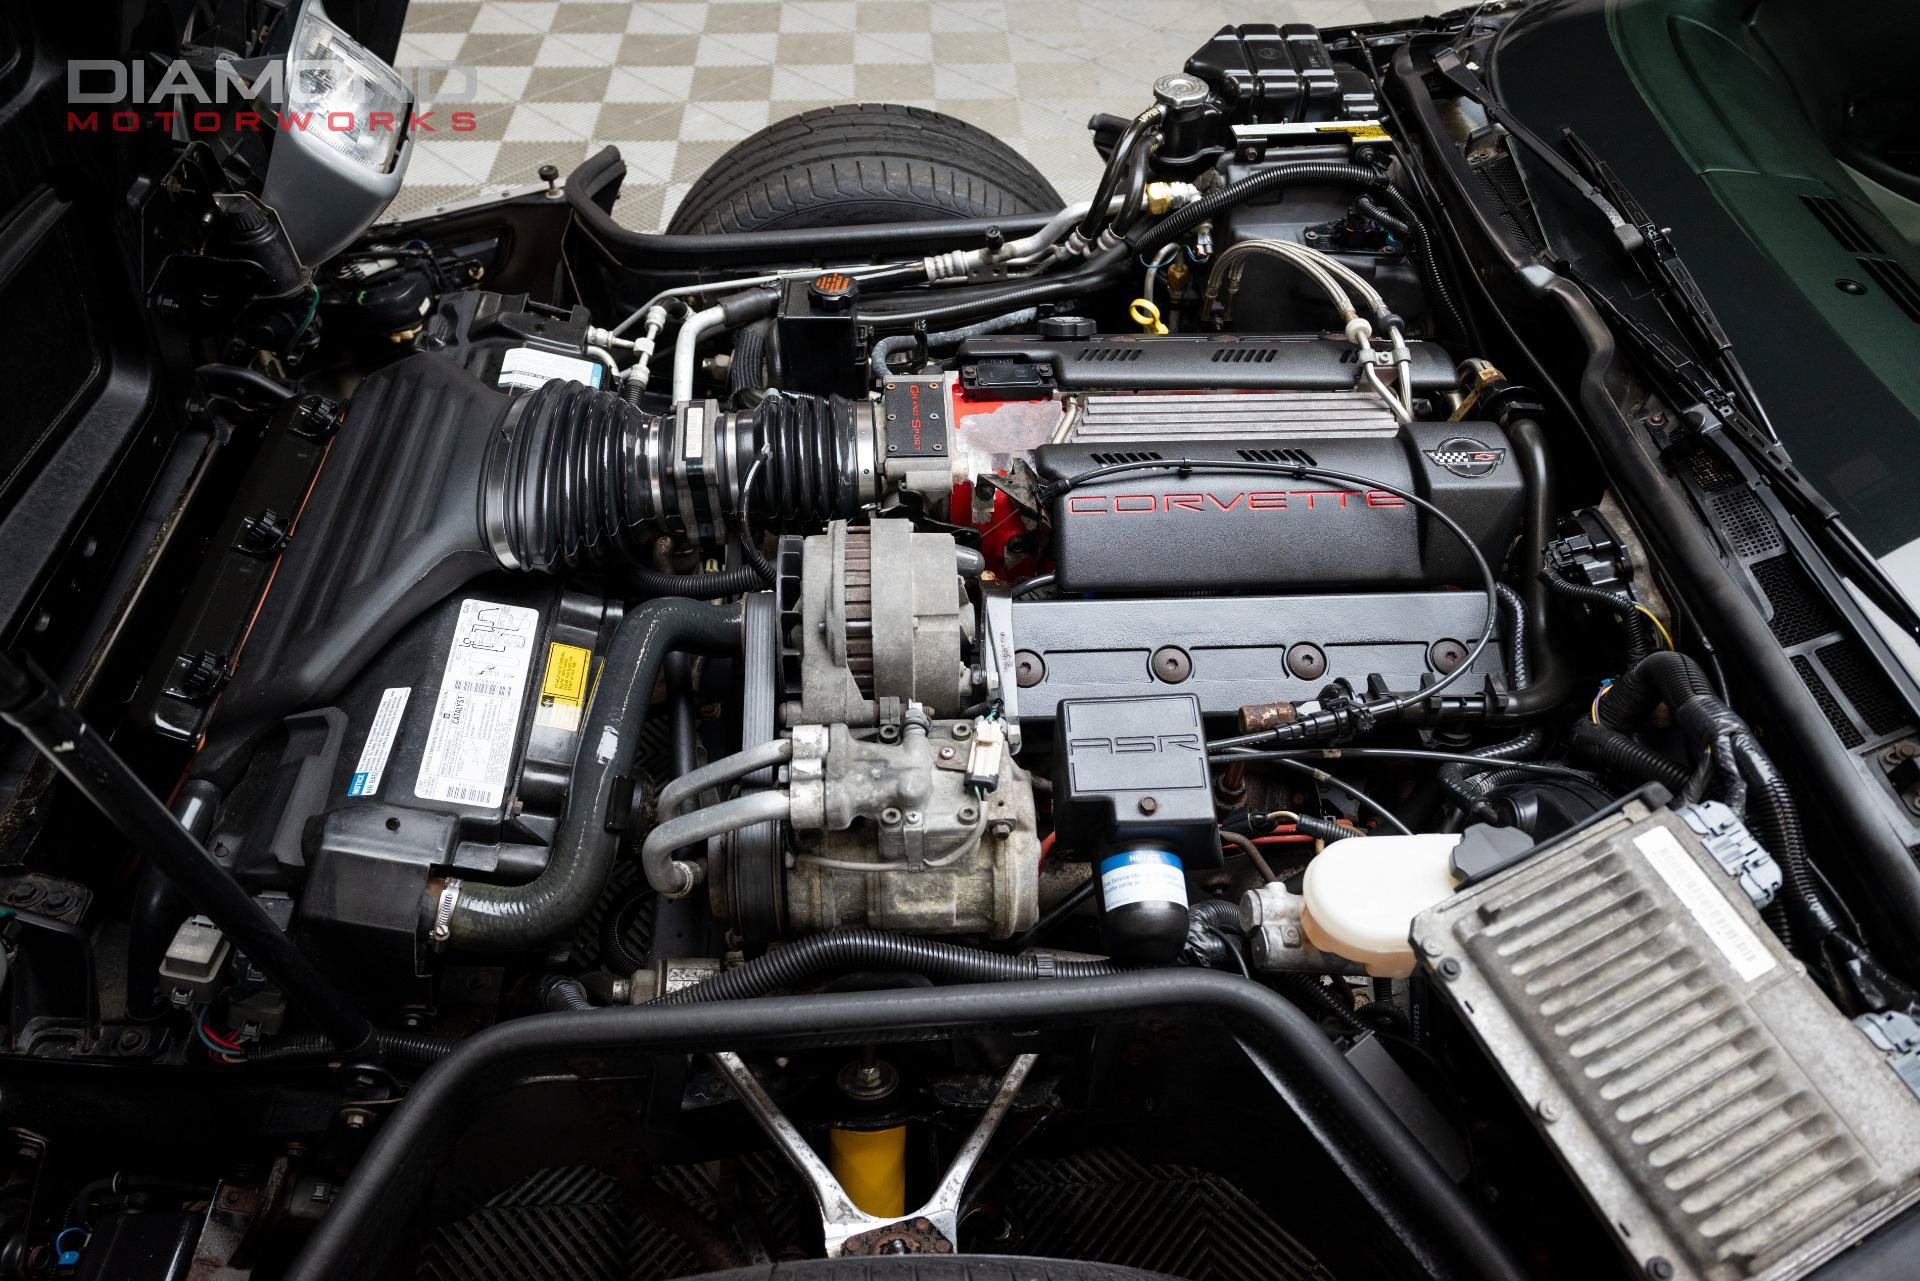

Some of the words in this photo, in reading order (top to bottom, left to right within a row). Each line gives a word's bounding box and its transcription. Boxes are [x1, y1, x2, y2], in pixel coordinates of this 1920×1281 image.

[909, 384, 920, 415] GRAND
[911, 419, 922, 451] SPORT
[1068, 489, 1405, 515] CORVETTE
[451, 695, 465, 725] CATALYST
[1070, 734, 1201, 755] ASR
